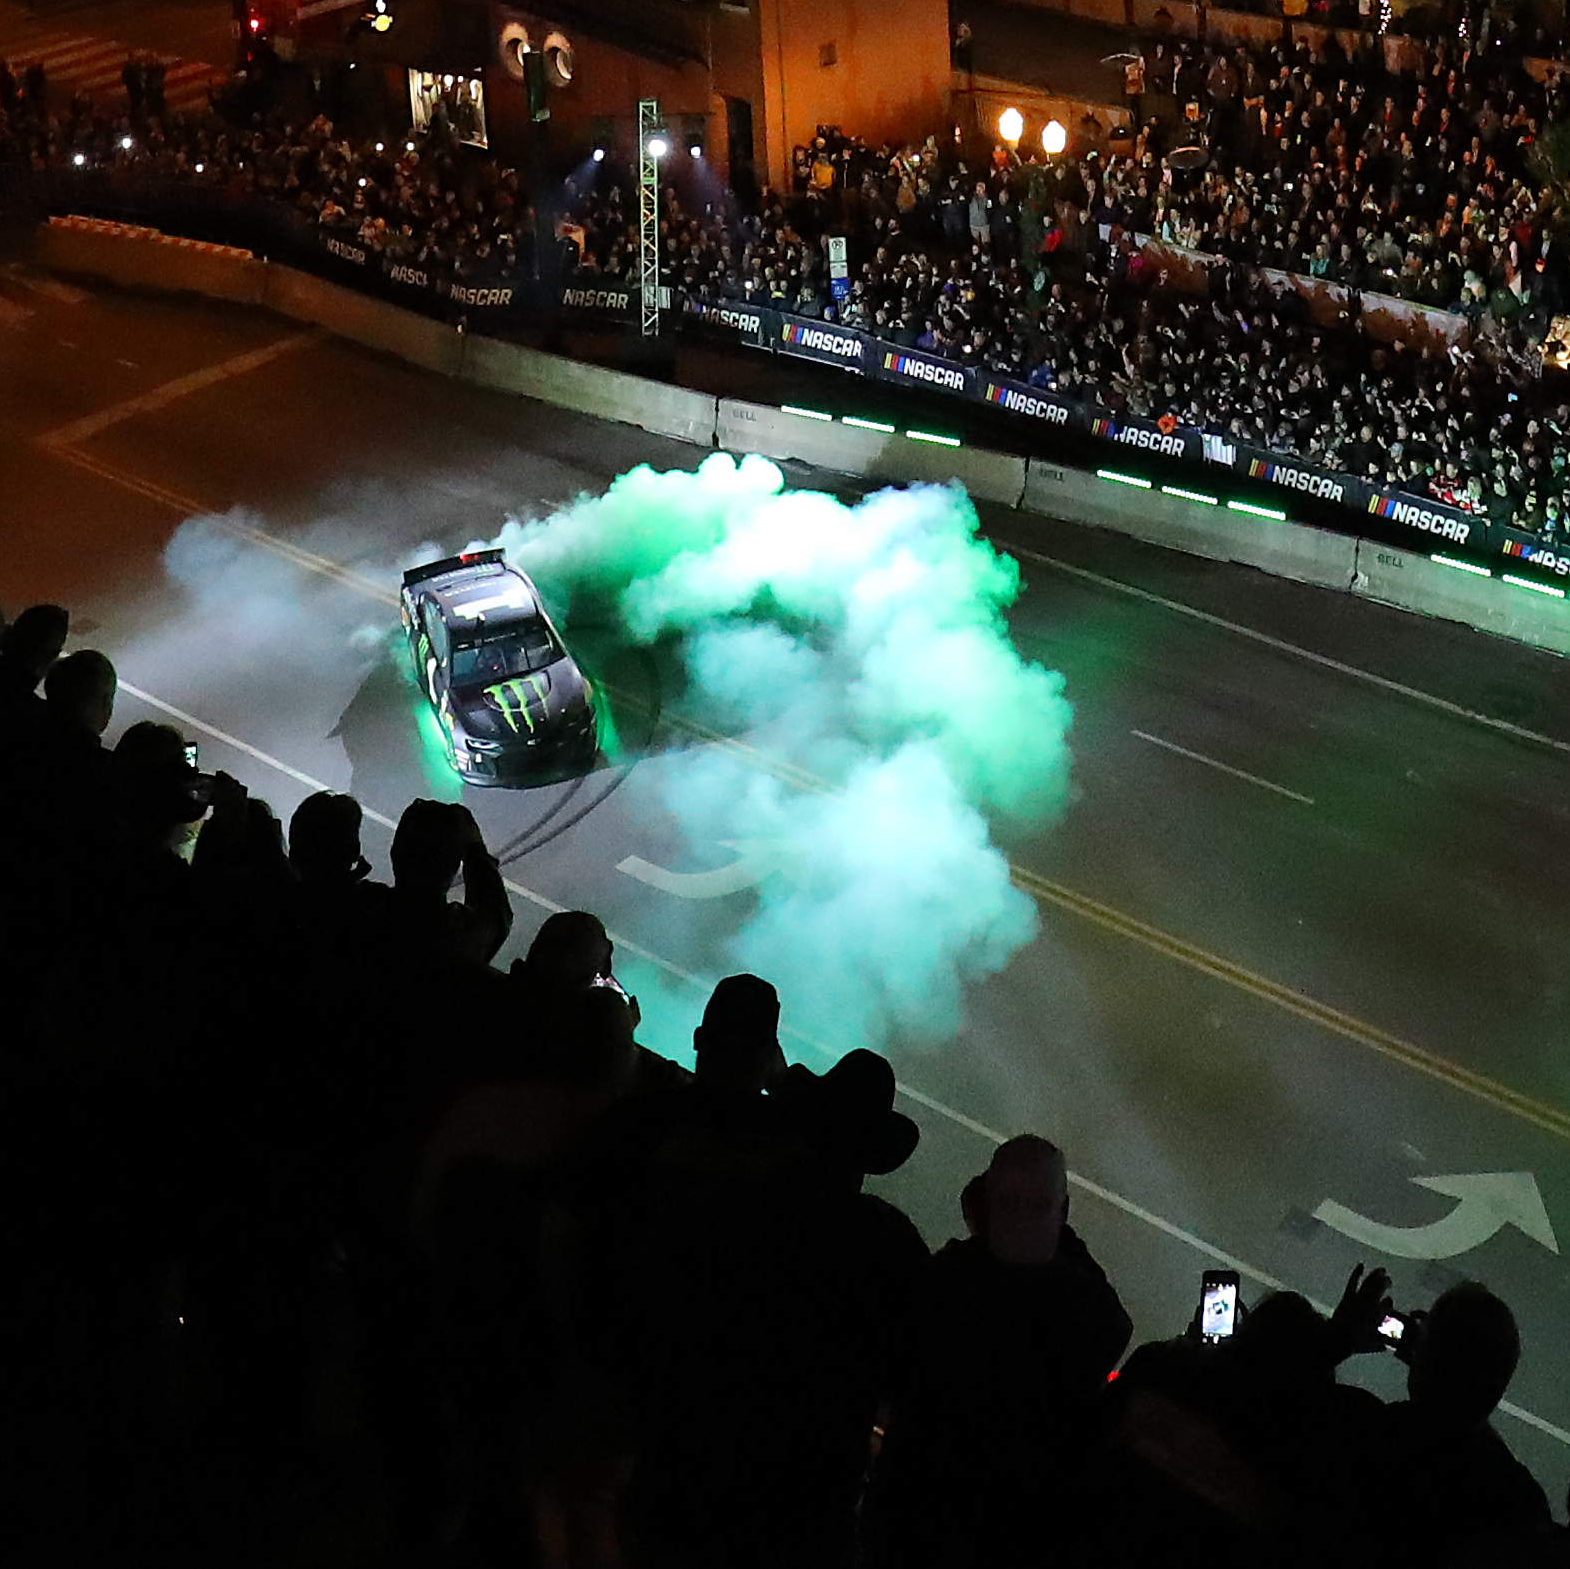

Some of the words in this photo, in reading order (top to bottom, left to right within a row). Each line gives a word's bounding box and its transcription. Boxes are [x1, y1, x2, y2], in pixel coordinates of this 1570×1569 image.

[451, 283, 513, 306] NASCAR
[563, 288, 628, 310] NASCAR
[801, 327, 862, 358] NASCAR
[903, 356, 965, 391] NASCAR
[1004, 389, 1069, 425] NASCAR
[1271, 464, 1344, 503] NASCAR
[1392, 500, 1470, 545] NASCAR
